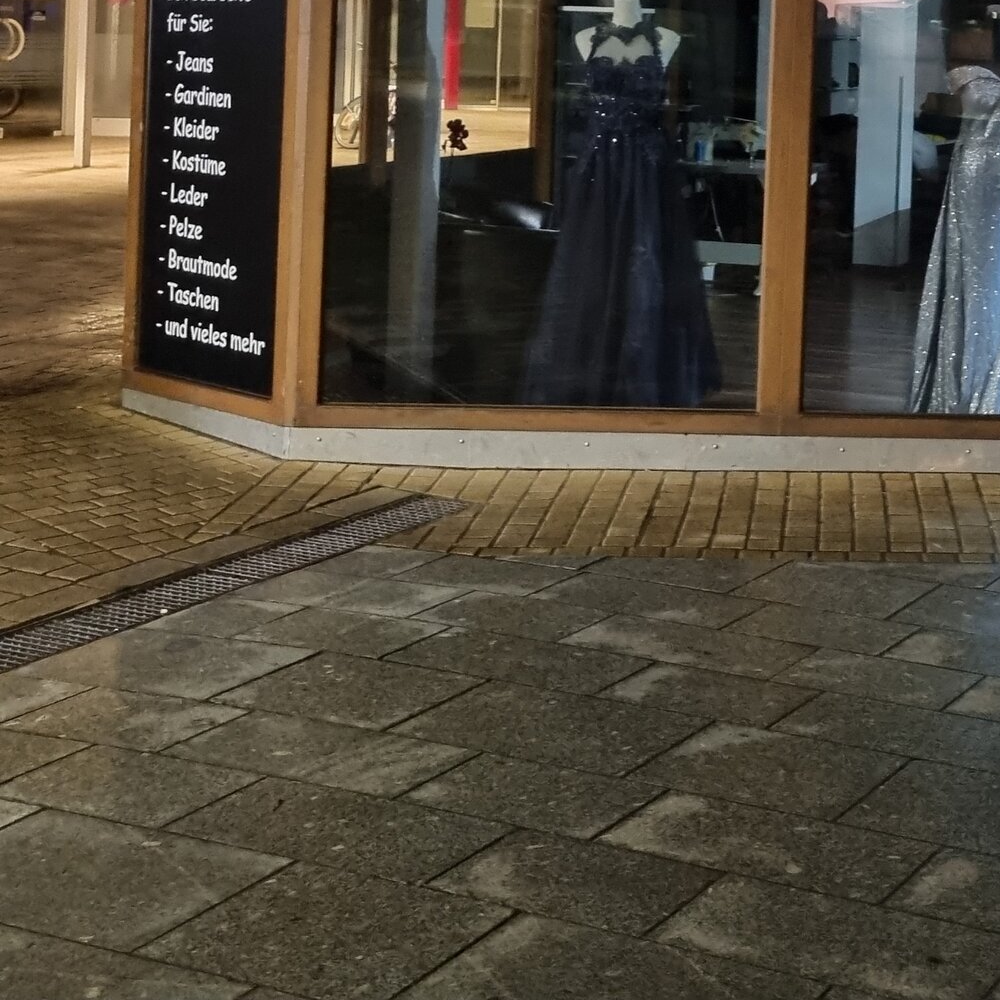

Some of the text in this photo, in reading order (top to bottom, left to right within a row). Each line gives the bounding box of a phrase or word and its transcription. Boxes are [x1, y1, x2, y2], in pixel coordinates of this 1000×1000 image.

[167, 12, 213, 32] für Sie:
[175, 51, 214, 73] Jeans
[174, 83, 232, 109] Gardinen
[173, 116, 220, 141] Kleider
[172, 150, 227, 176] Kostüme
[170, 182, 208, 207] Leder
[168, 215, 203, 240] Pelze
[168, 248, 238, 280] Brautmode
[167, 282, 219, 312] Taschen
[165, 318, 188, 339] und
[190, 322, 228, 348] vieles
[230, 332, 266, 356] mehr
